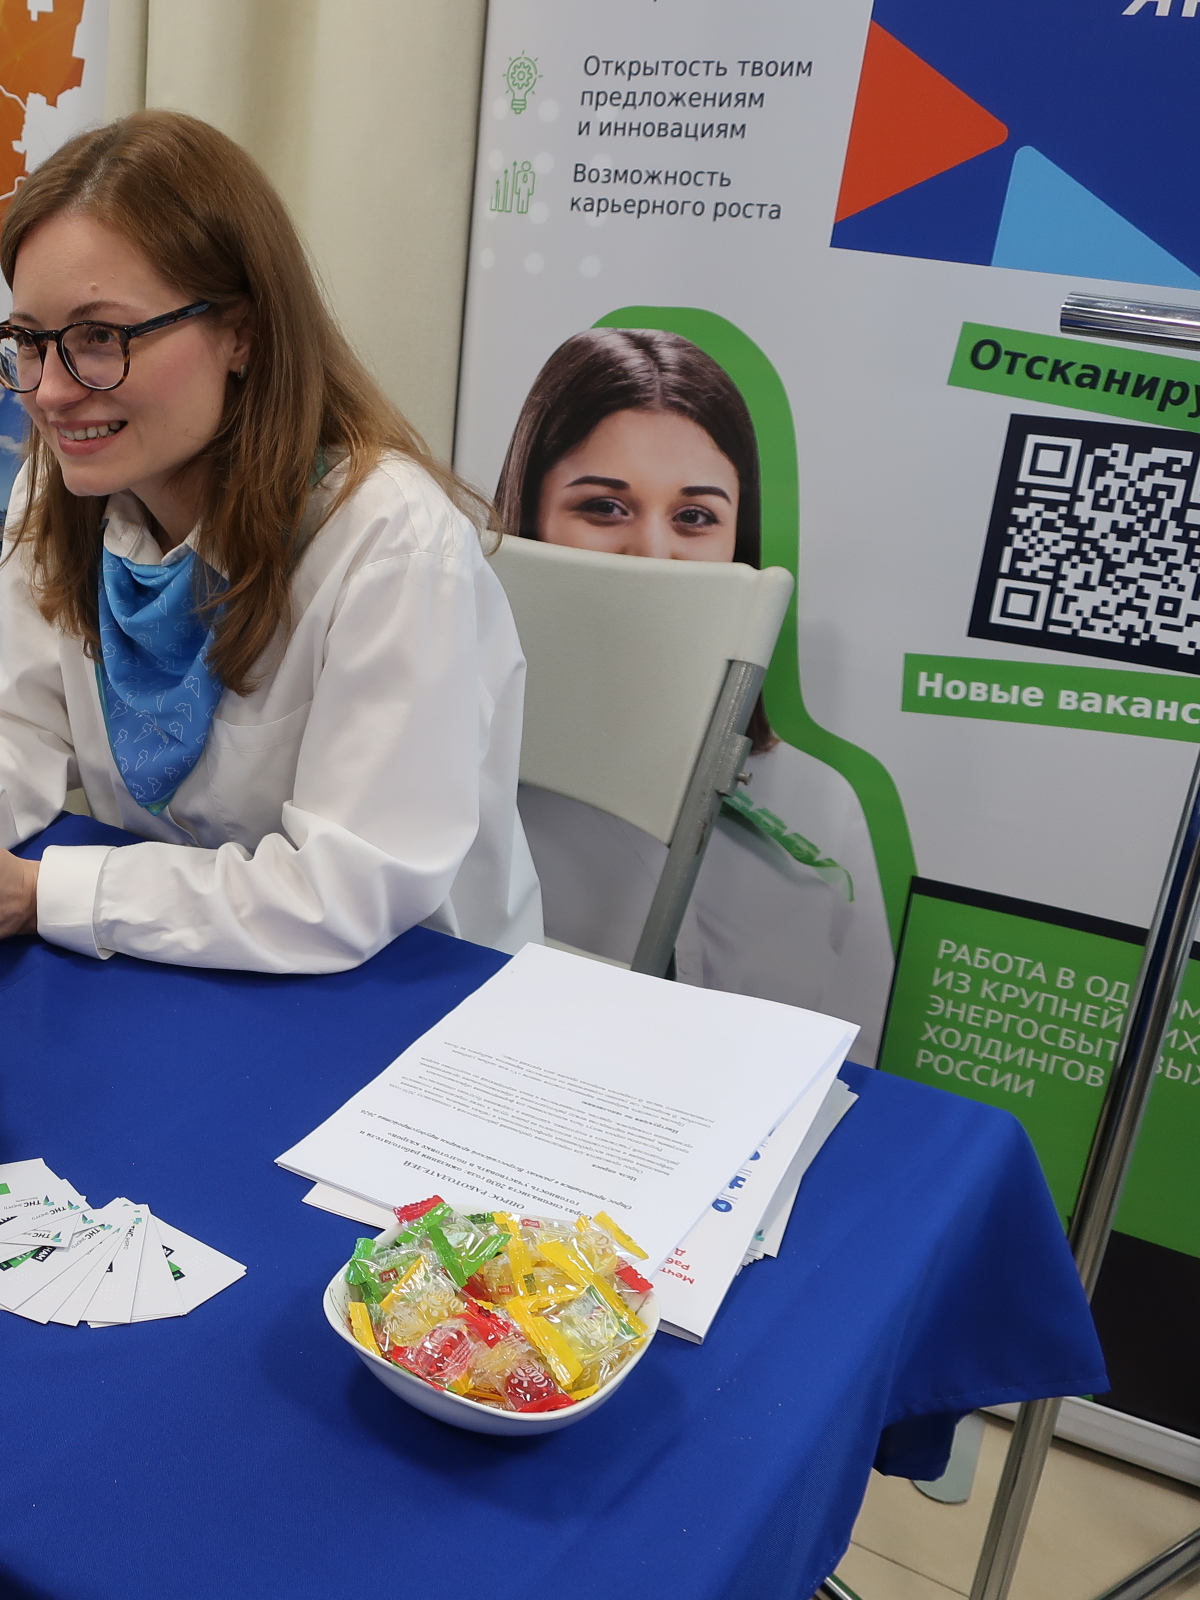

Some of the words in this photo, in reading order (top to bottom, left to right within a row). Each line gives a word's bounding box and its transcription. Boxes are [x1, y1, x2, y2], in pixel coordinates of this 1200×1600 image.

[584, 55, 728, 81] Открытость
[737, 59, 813, 77] твоим
[580, 89, 765, 111] предложениям
[578, 120, 591, 136] и
[598, 120, 746, 142] инновациям
[573, 163, 731, 188] Возможность
[569, 196, 705, 219] карьерного
[712, 200, 782, 222] роста
[917, 670, 1045, 708] Новые
[937, 939, 1048, 984] РАБОТА
[1056, 967, 1076, 990] В
[931, 967, 972, 994] ИЗ
[920, 1022, 1106, 1088] ХОЛДИНГОВ
[915, 1048, 1036, 1098] РОССИИ
[366, 1132, 420, 1155] работодателя
[420, 1144, 467, 1164] подготовке
[421, 1153, 462, 1171] ожидания
[591, 1163, 616, 1173] опроса
[403, 1160, 487, 1195] РАБОТОДАТЕЛЕЙ
[463, 1169, 485, 1180] года:
[476, 1165, 529, 1187] участвовать
[485, 1178, 506, 1189] 2030
[618, 1172, 637, 1181] Цель
[23, 1200, 42, 1208] ТНС
[488, 1193, 524, 1209] ОПРОС
[507, 1186, 562, 1208] специалиста
[530, 1185, 579, 1205] готовность
[607, 1199, 632, 1209] Опрос
[49, 1206, 67, 1216] ТНС
[85, 1228, 101, 1240] ТНС
[35, 1246, 53, 1260] НАМ
